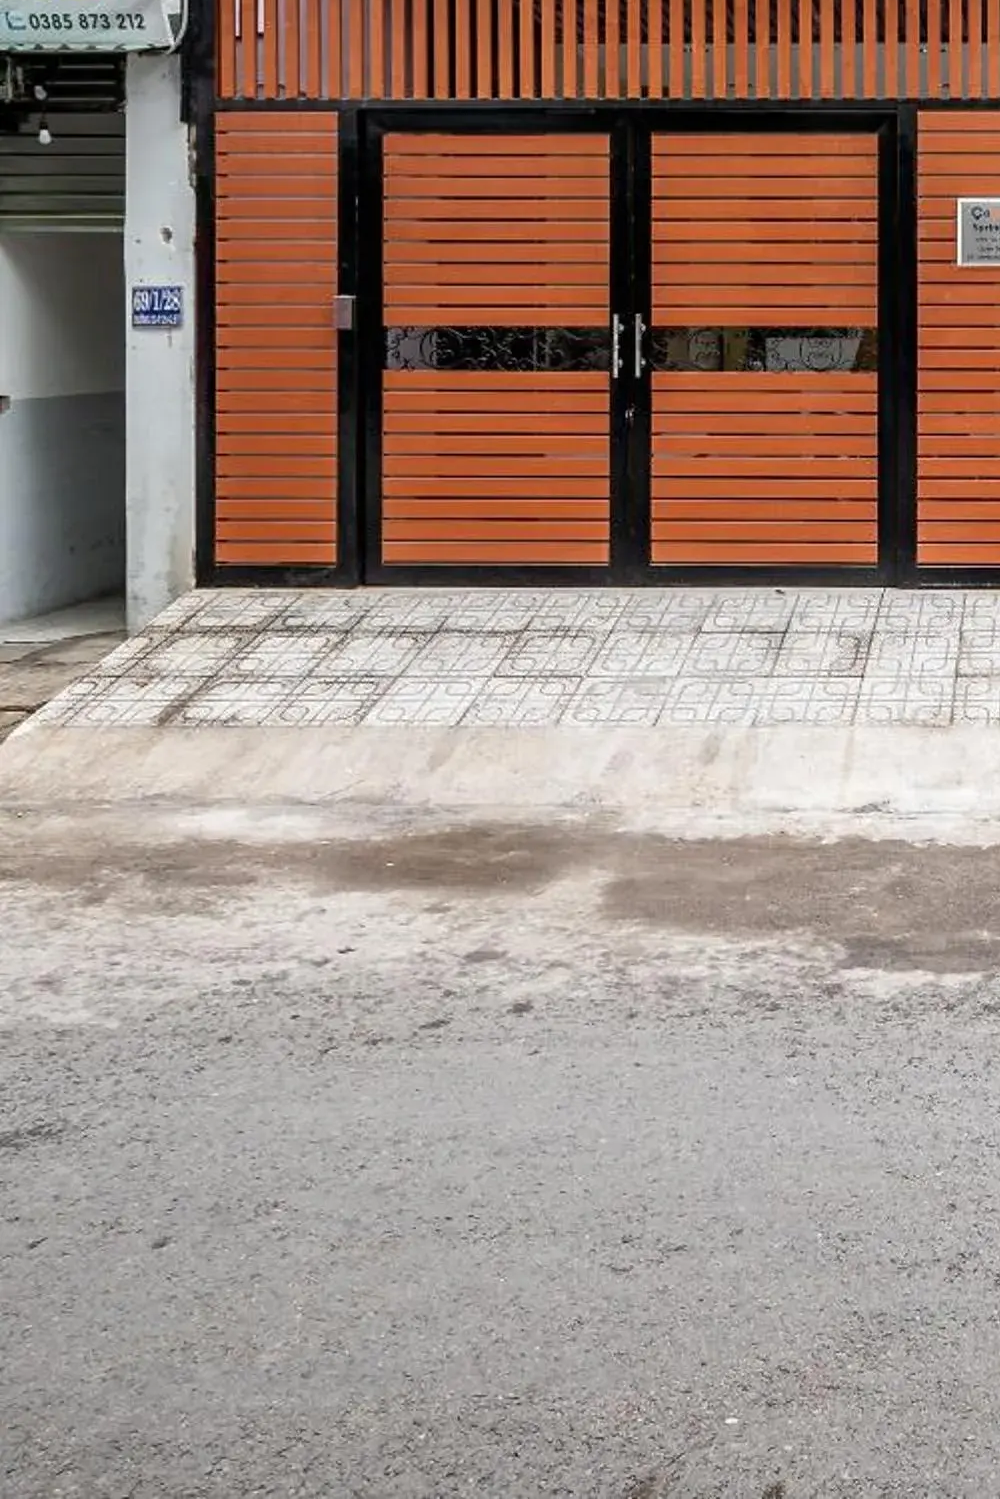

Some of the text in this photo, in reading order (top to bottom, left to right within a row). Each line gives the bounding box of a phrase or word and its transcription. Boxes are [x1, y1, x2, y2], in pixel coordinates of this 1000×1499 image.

[29, 13, 146, 30] 0385 873 212
